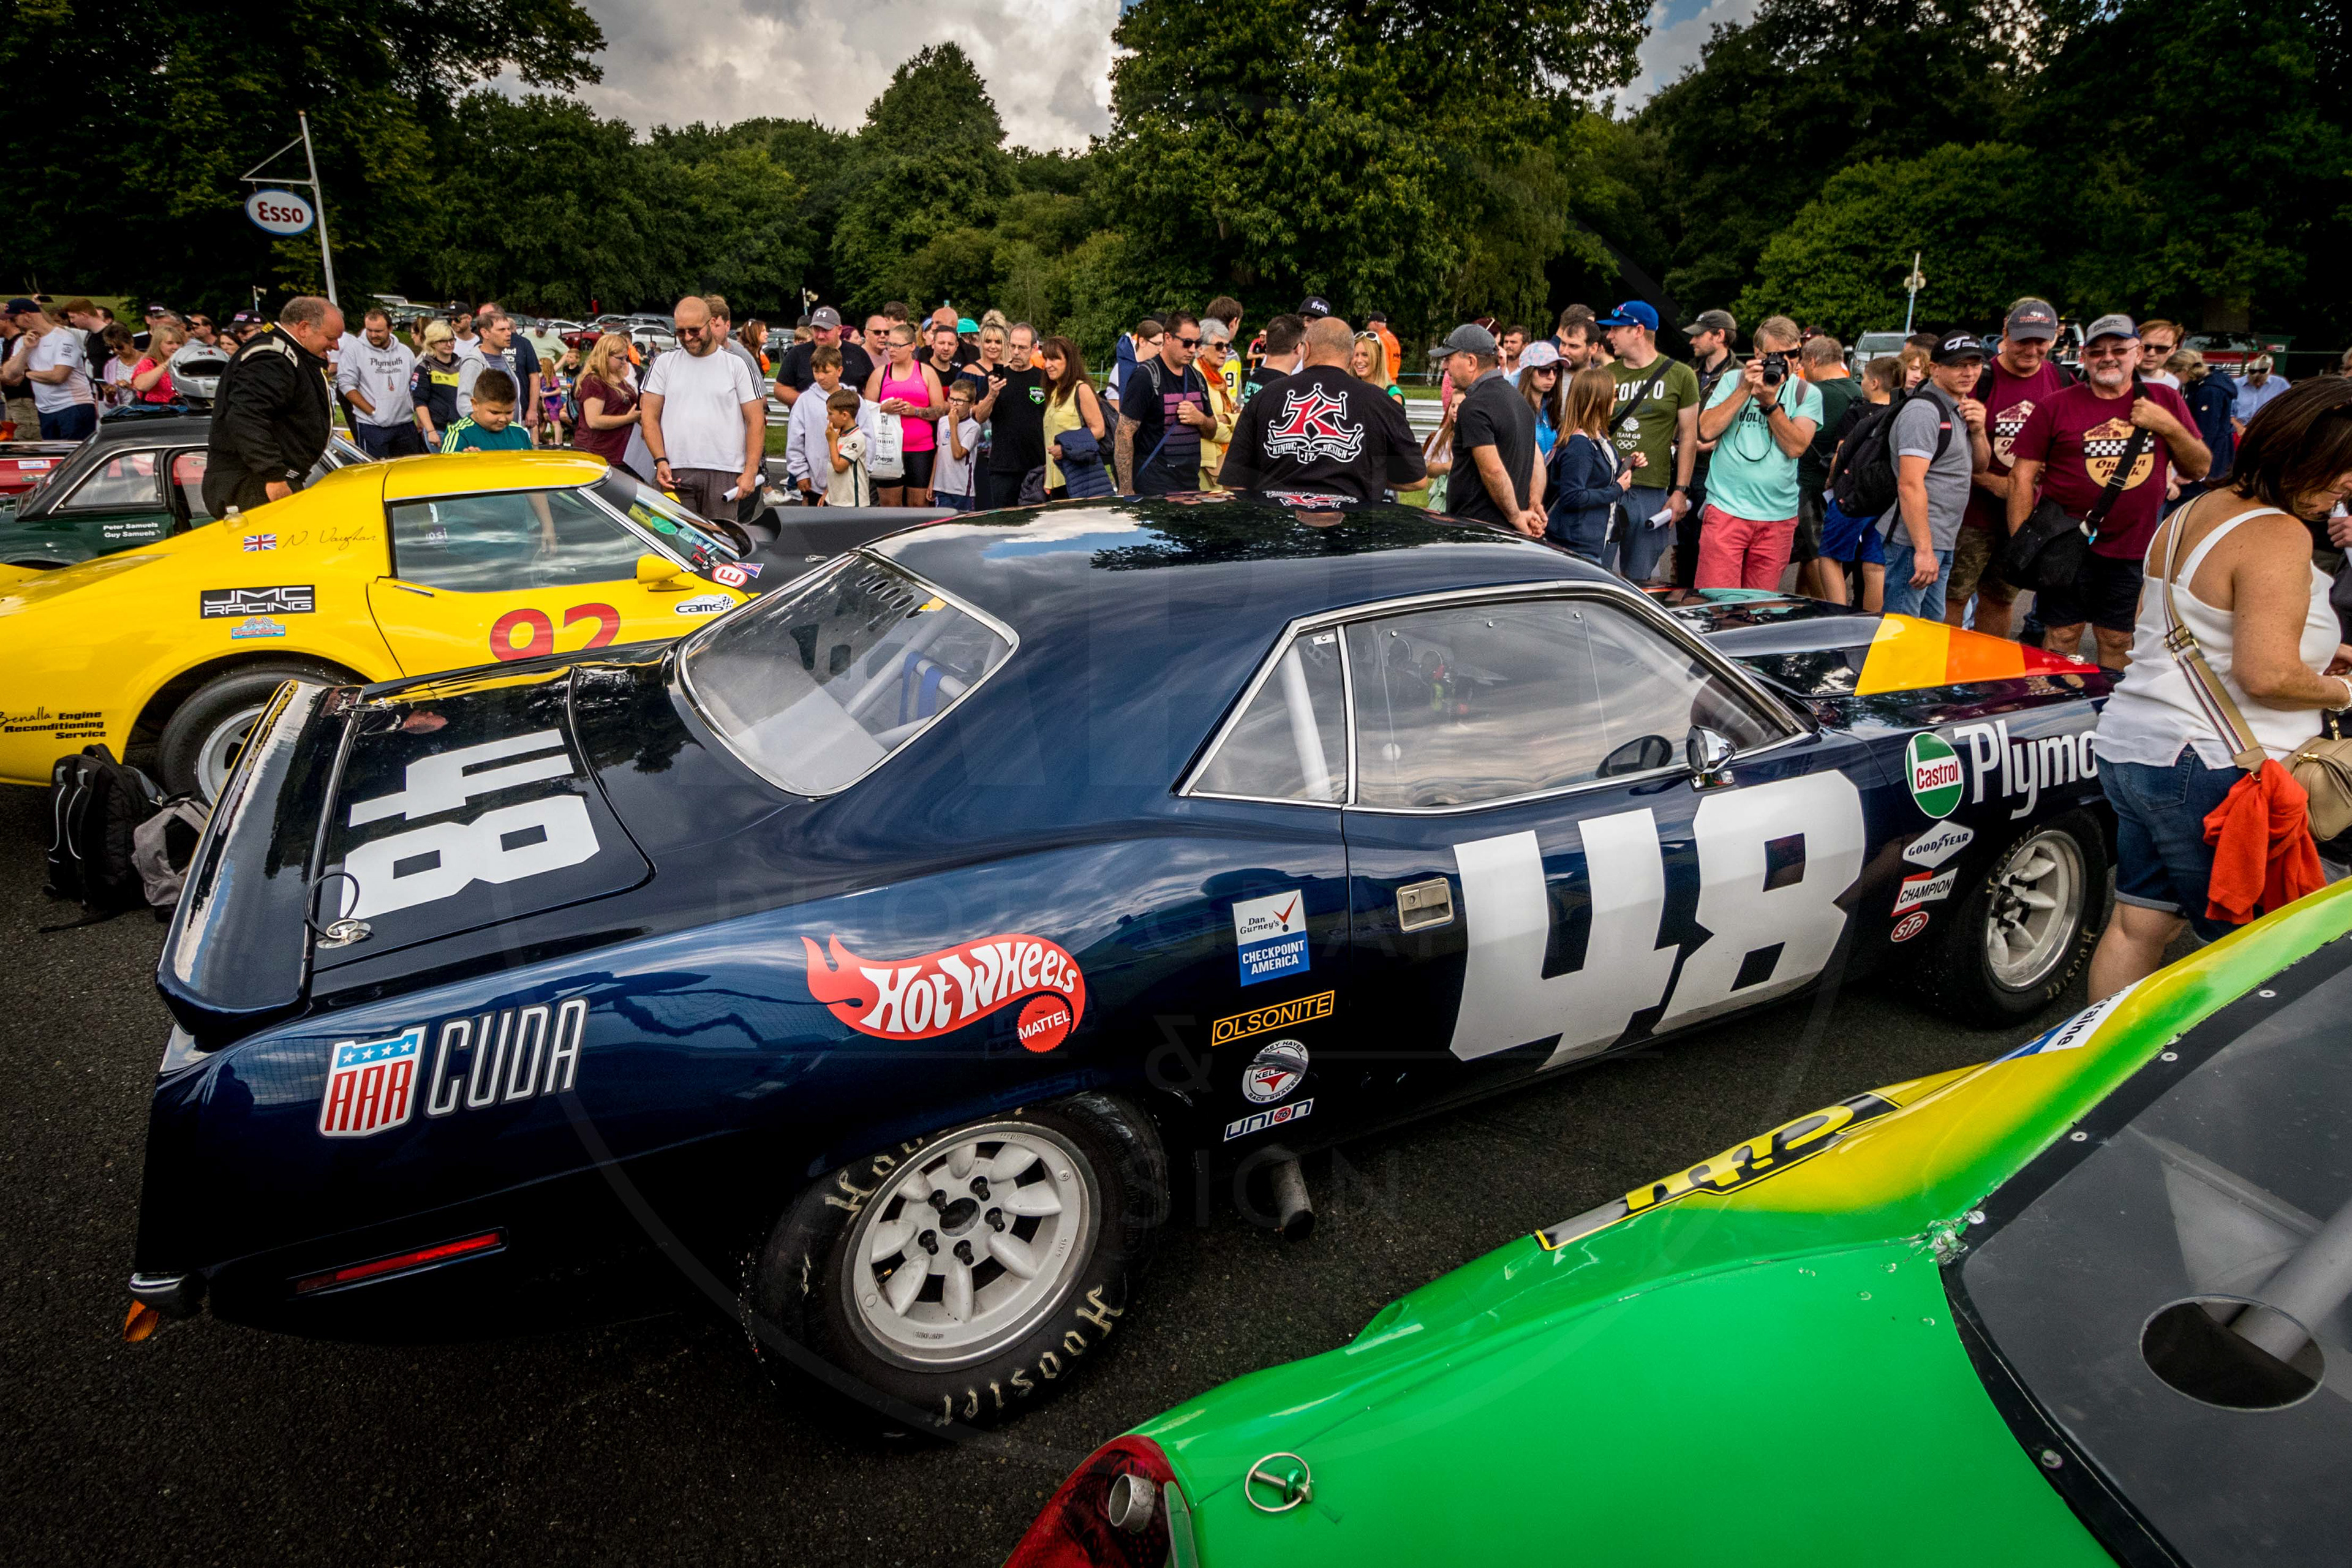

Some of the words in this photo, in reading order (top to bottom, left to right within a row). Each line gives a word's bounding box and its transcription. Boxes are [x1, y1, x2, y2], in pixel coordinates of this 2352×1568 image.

[1615, 380, 1665, 402] OKO
[204, 587, 312, 606] JMC
[676, 602, 724, 613] cams
[205, 600, 312, 616] RACING
[490, 602, 620, 662] 92
[5, 721, 104, 733] Reconditioning
[59, 711, 102, 721] Engine
[55, 731, 107, 739] Service
[1916, 760, 1959, 790] Castrol
[1953, 720, 2098, 820] Plymo
[339, 728, 600, 919] 48
[1899, 878, 1953, 904] CHAMPION
[1240, 919, 1280, 935] Gurney's
[1248, 916, 1266, 927] Dan
[1449, 769, 1866, 1073] 48
[1894, 915, 1924, 938] STP
[1242, 940, 1305, 965] CHECKPOINT
[1251, 955, 1299, 975] AMERICA
[1017, 1010, 1071, 1041] MATTEL
[1216, 995, 1332, 1040] OLSONITE
[427, 999, 587, 1116] CUDA
[1283, 1041, 1305, 1053] HAYES
[324, 1060, 414, 1132] AAR
[1248, 1092, 1266, 1101] RACE
